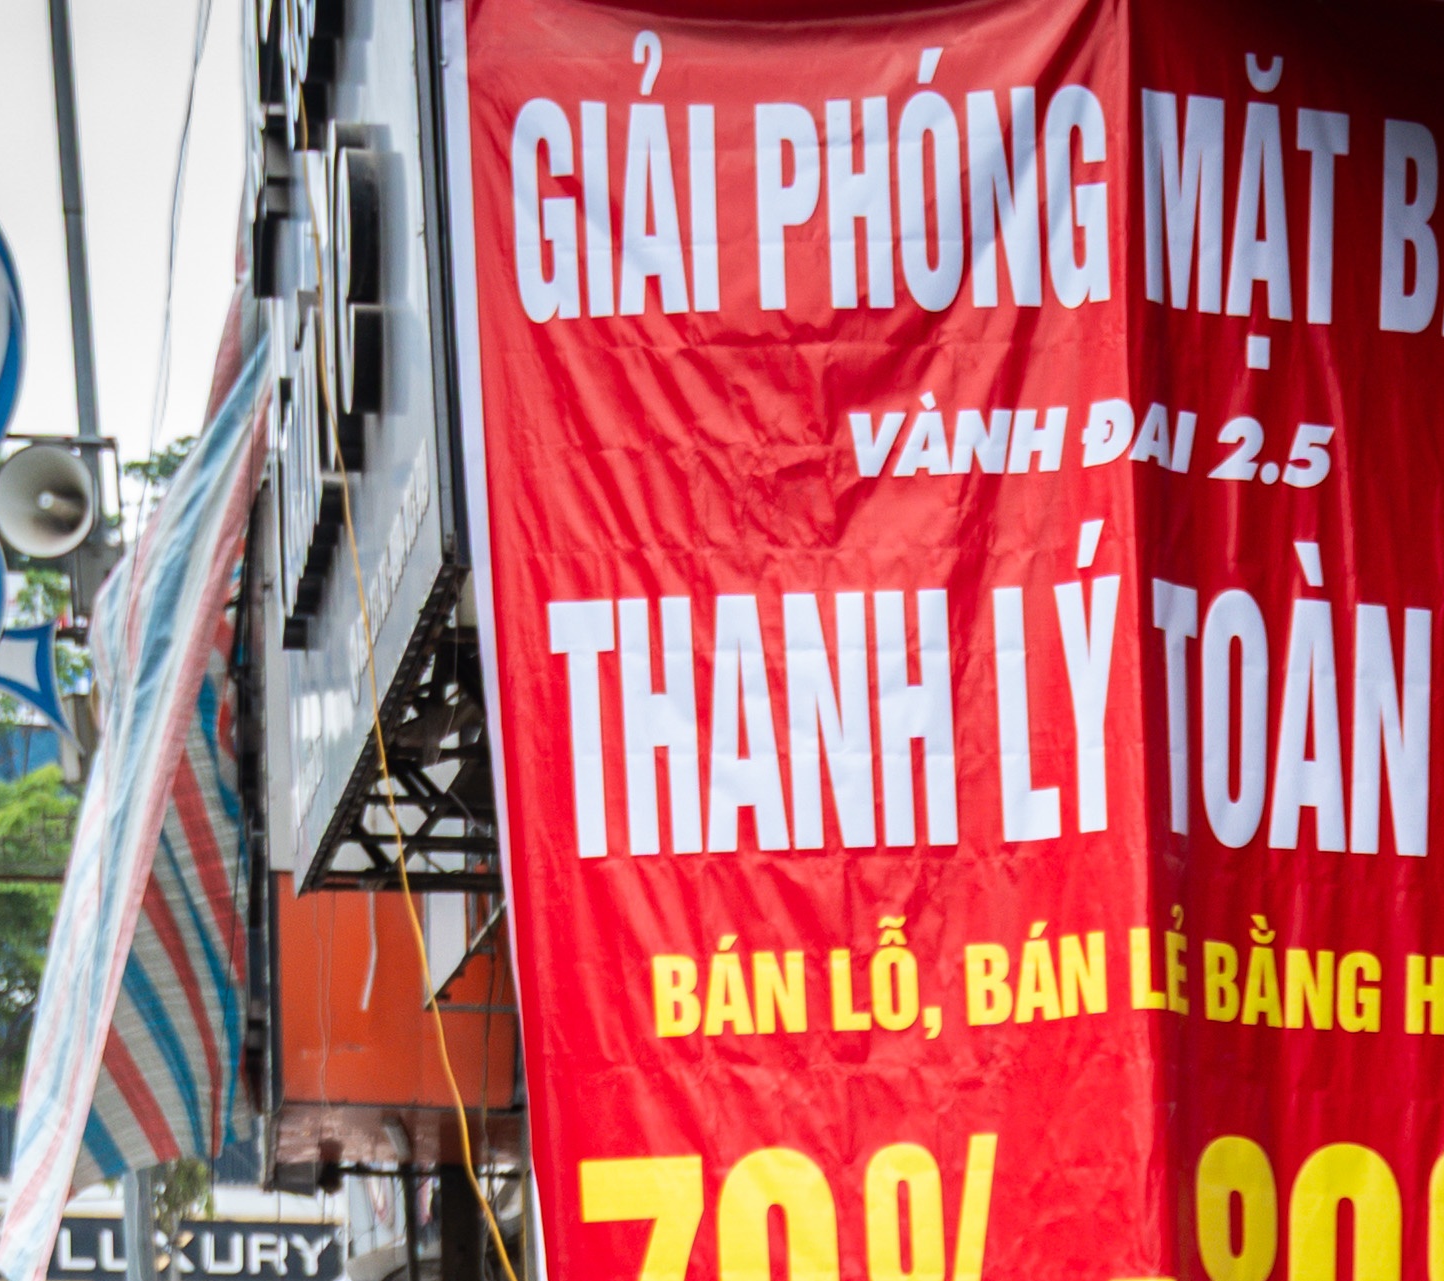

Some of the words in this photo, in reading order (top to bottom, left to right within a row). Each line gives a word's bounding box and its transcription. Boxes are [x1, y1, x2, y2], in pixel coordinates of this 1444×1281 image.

[512, 29, 720, 324] GIẢI
[756, 46, 1112, 311] PHÓNG
[1142, 52, 1349, 369] MẶT
[848, 393, 1068, 477] VÀNH
[1082, 399, 1197, 470] ĐAI
[1209, 424, 1335, 488] 2.5
[547, 590, 958, 859] THANH
[993, 519, 1122, 844] LÝ
[1153, 541, 1432, 858] TOÀN
[653, 935, 806, 1040] BÁN
[832, 916, 943, 1042] LỖ,
[965, 920, 1108, 1025] BÁN
[1128, 905, 1191, 1015] LẺ
[1204, 914, 1383, 1034] BẰNG
